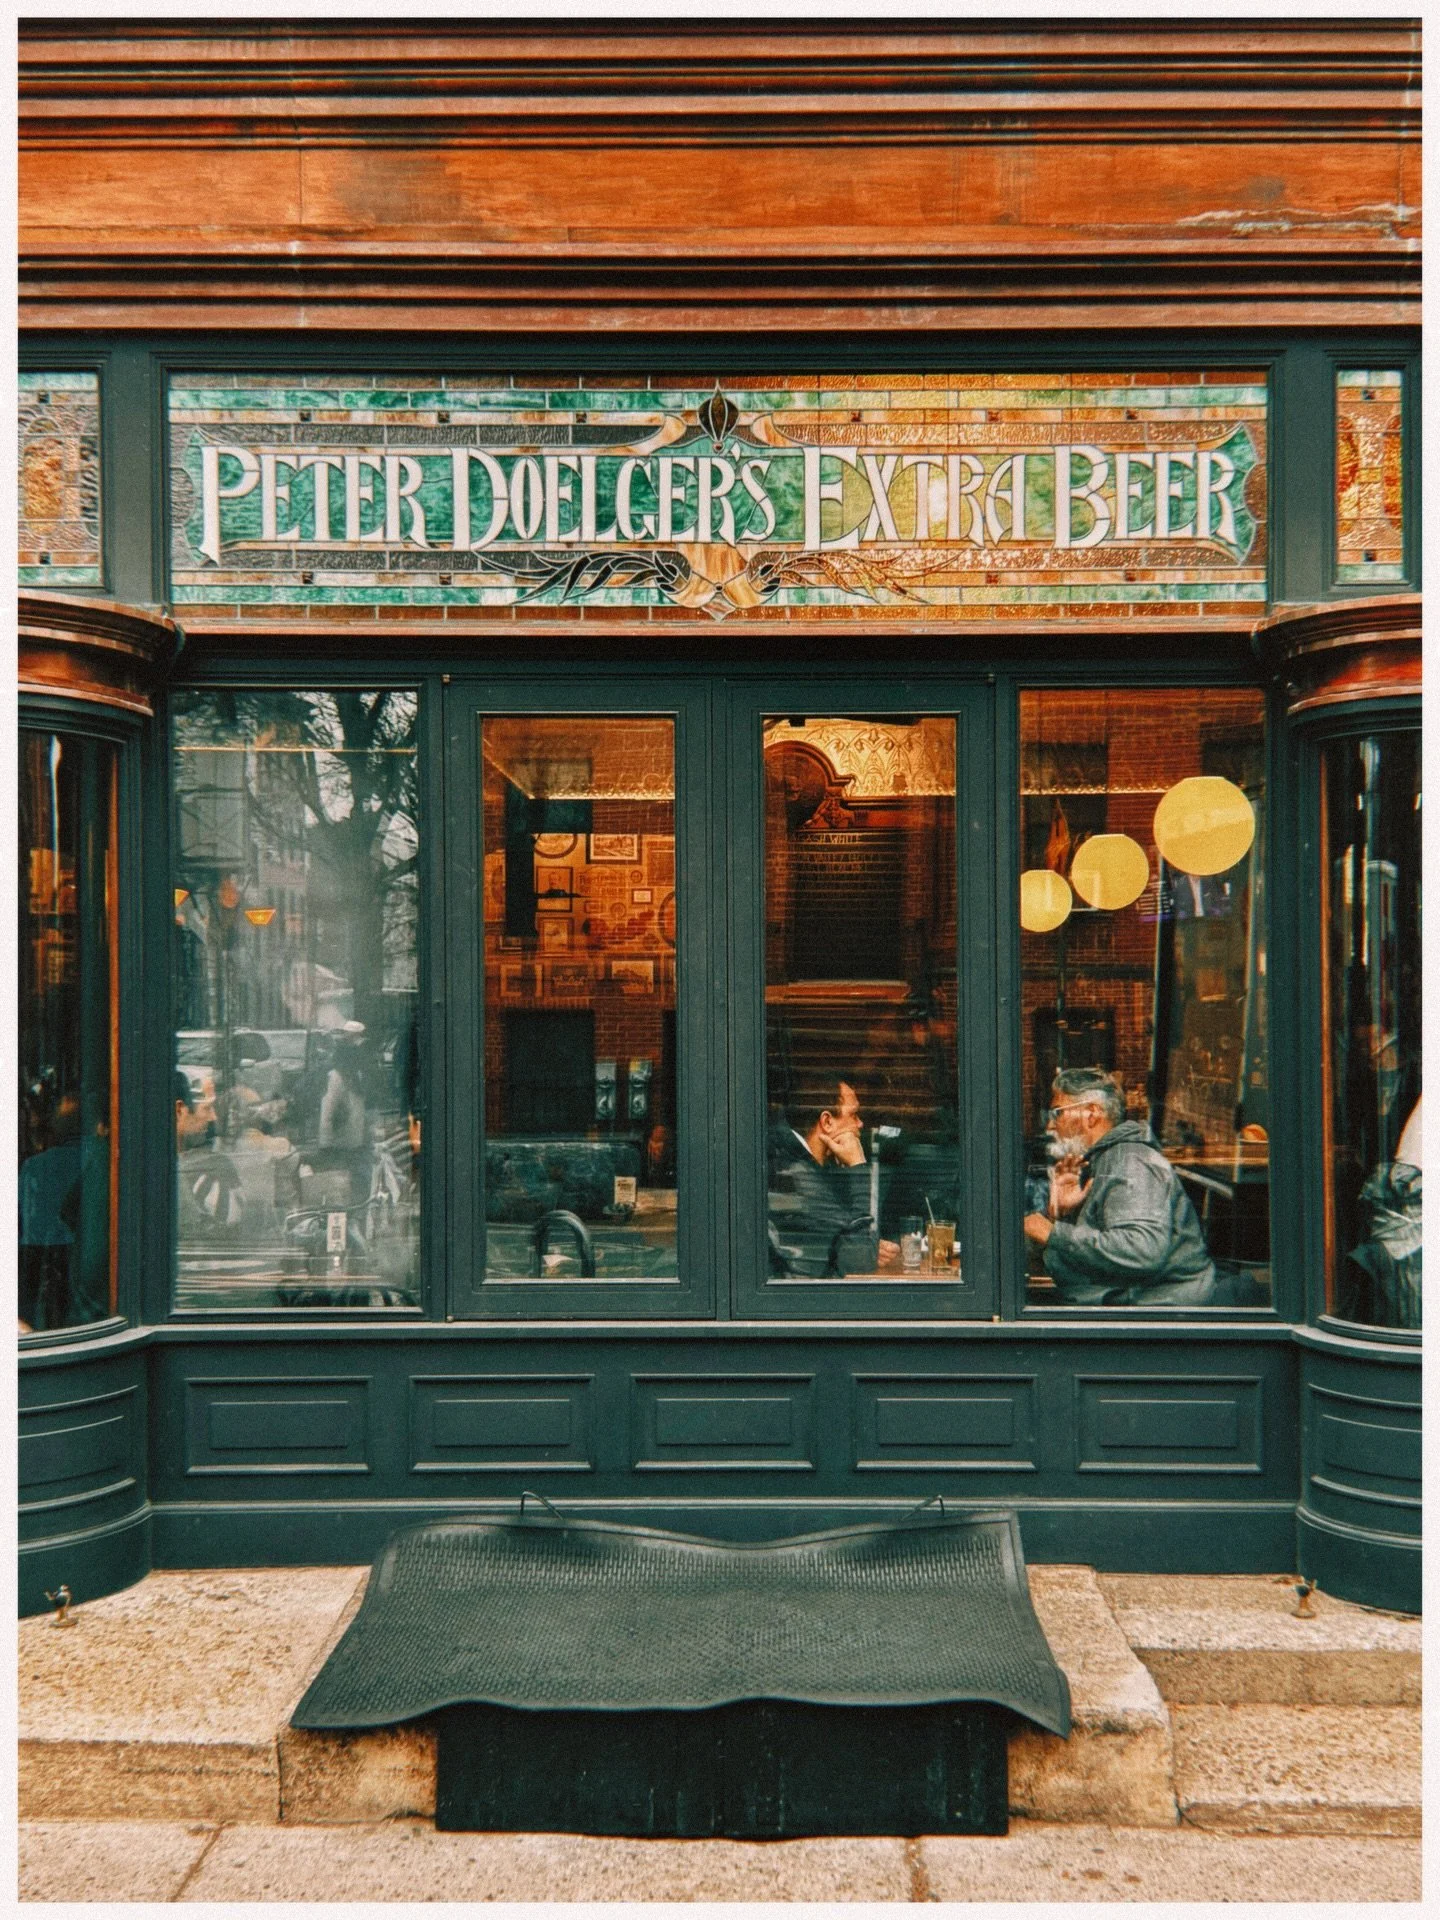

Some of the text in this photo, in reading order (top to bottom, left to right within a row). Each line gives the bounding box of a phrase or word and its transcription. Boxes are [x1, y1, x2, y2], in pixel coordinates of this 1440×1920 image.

[200, 443, 1239, 565] PETER DOELGER'S EXTRA BEER
